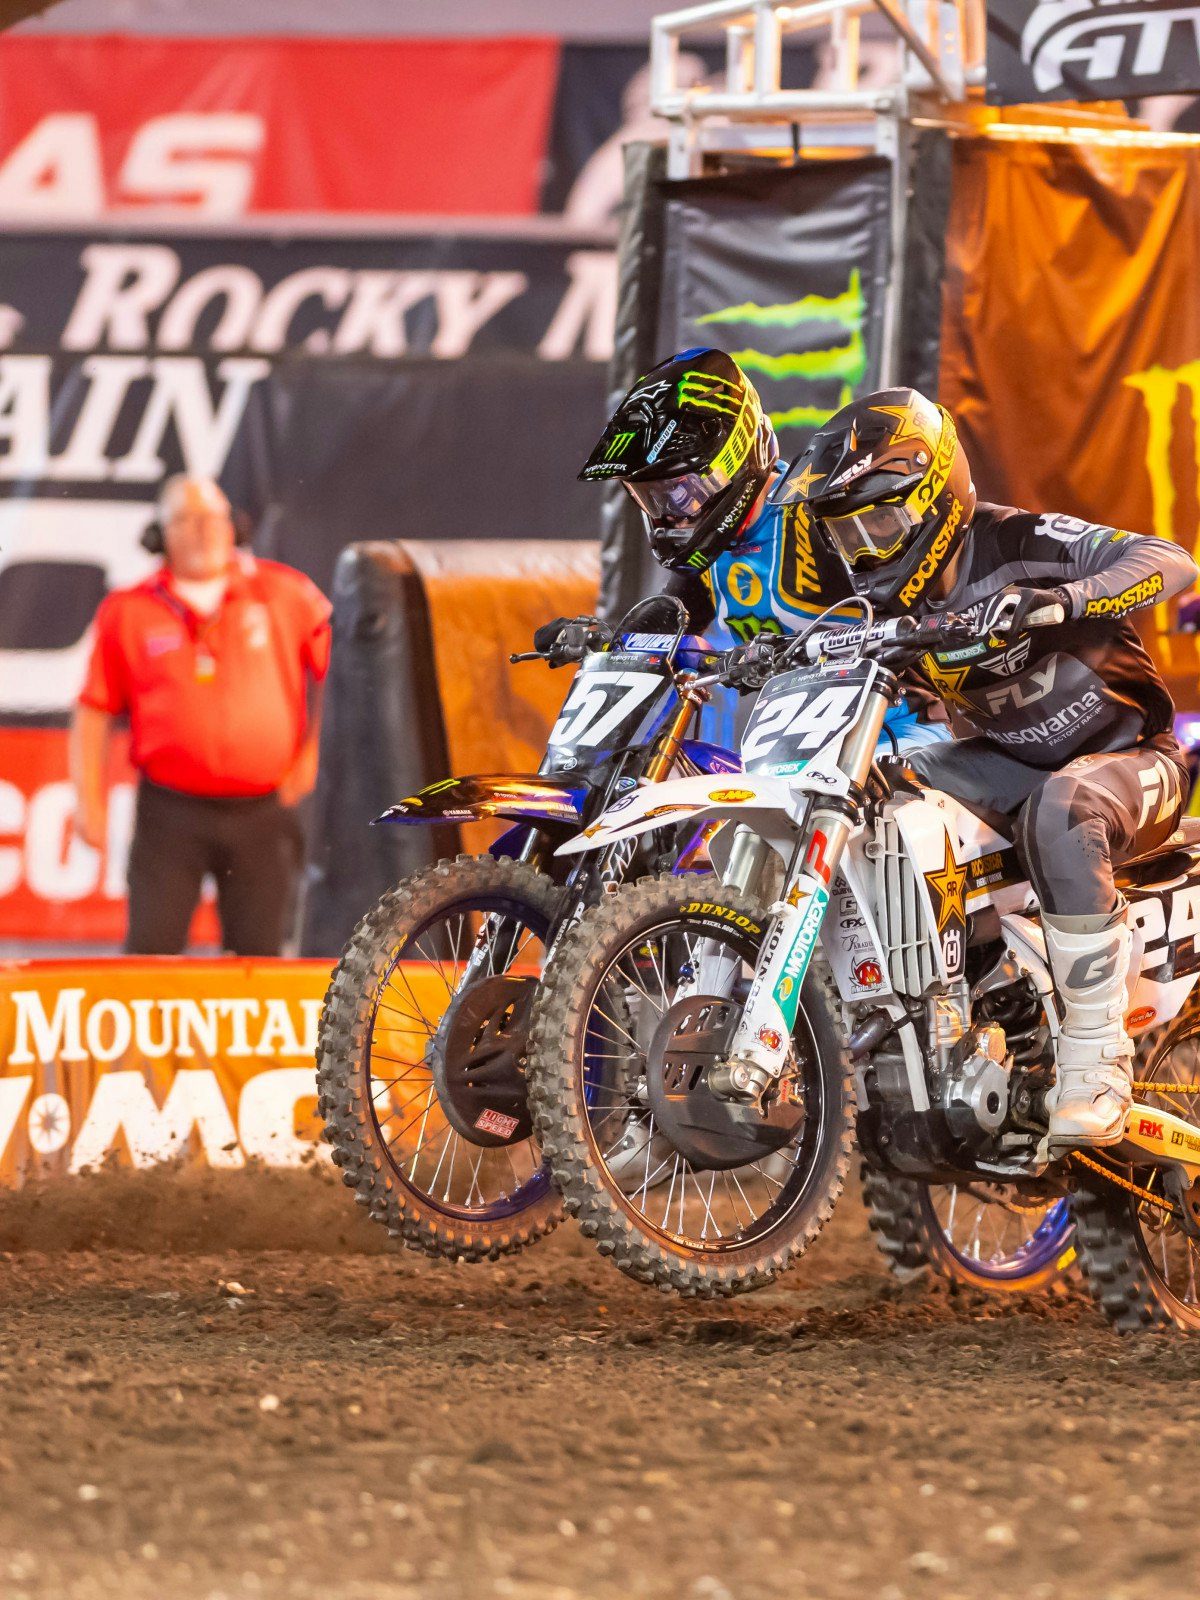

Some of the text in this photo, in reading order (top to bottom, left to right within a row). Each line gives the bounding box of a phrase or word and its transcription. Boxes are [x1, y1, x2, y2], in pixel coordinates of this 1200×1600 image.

[62, 244, 527, 360] ROCKY
[584, 463, 628, 474] MONSTER
[898, 498, 965, 608] ROCKSTAR
[947, 645, 985, 659] MOTOREX
[985, 653, 1058, 716] FLY
[547, 671, 665, 747] 57
[744, 685, 864, 762] 24
[1048, 701, 1107, 747] FACTORY RACING
[710, 790, 755, 802] FMF
[686, 902, 761, 934] DUNLOP
[783, 896, 828, 978] MOTOREX
[745, 919, 786, 1013] DUNLOP
[477, 1120, 513, 1137] SPEED
[482, 1109, 519, 1129] LIGHT
[1139, 1118, 1164, 1138] RK
